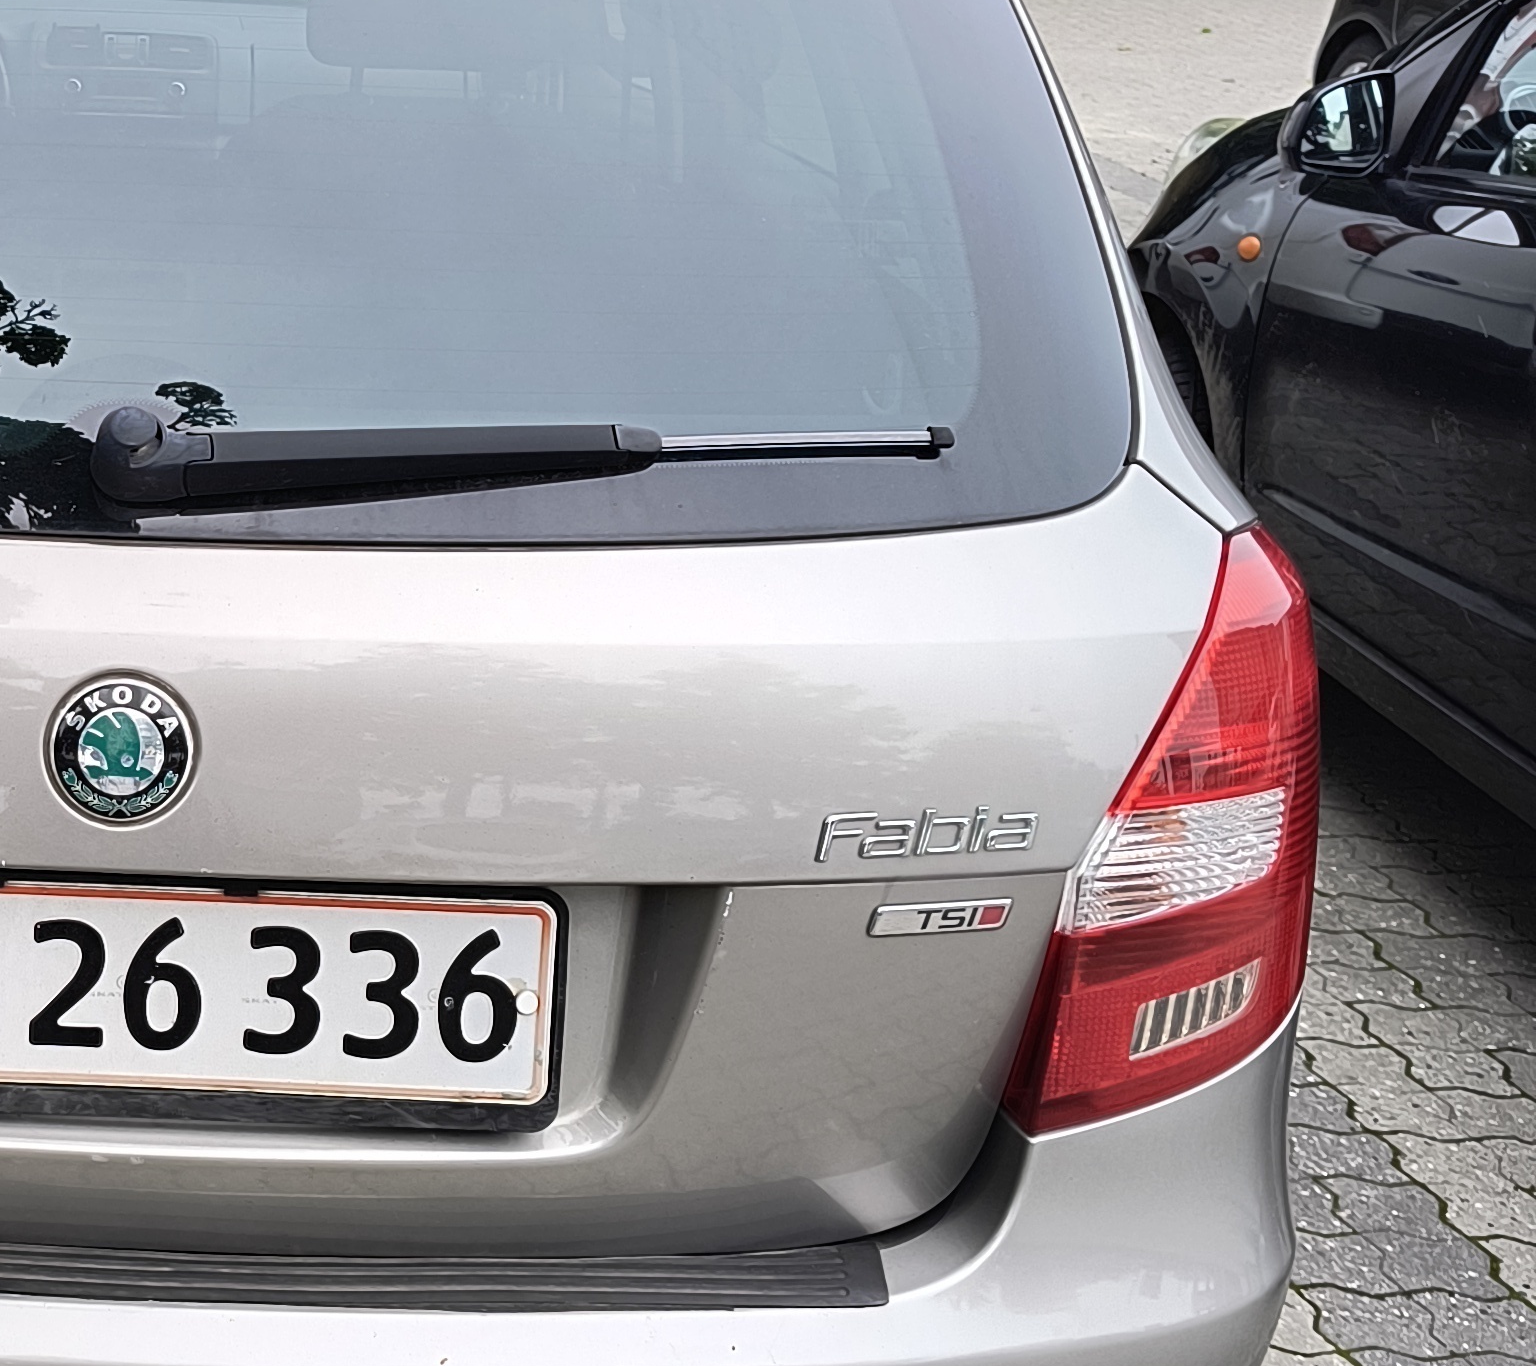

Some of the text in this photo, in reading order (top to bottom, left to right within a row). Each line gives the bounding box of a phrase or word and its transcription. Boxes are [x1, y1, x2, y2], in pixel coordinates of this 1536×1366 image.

[814, 805, 1039, 864] Fabia
[916, 906, 979, 931] TSI
[27, 915, 203, 1051] 26
[241, 925, 519, 1064] 336
